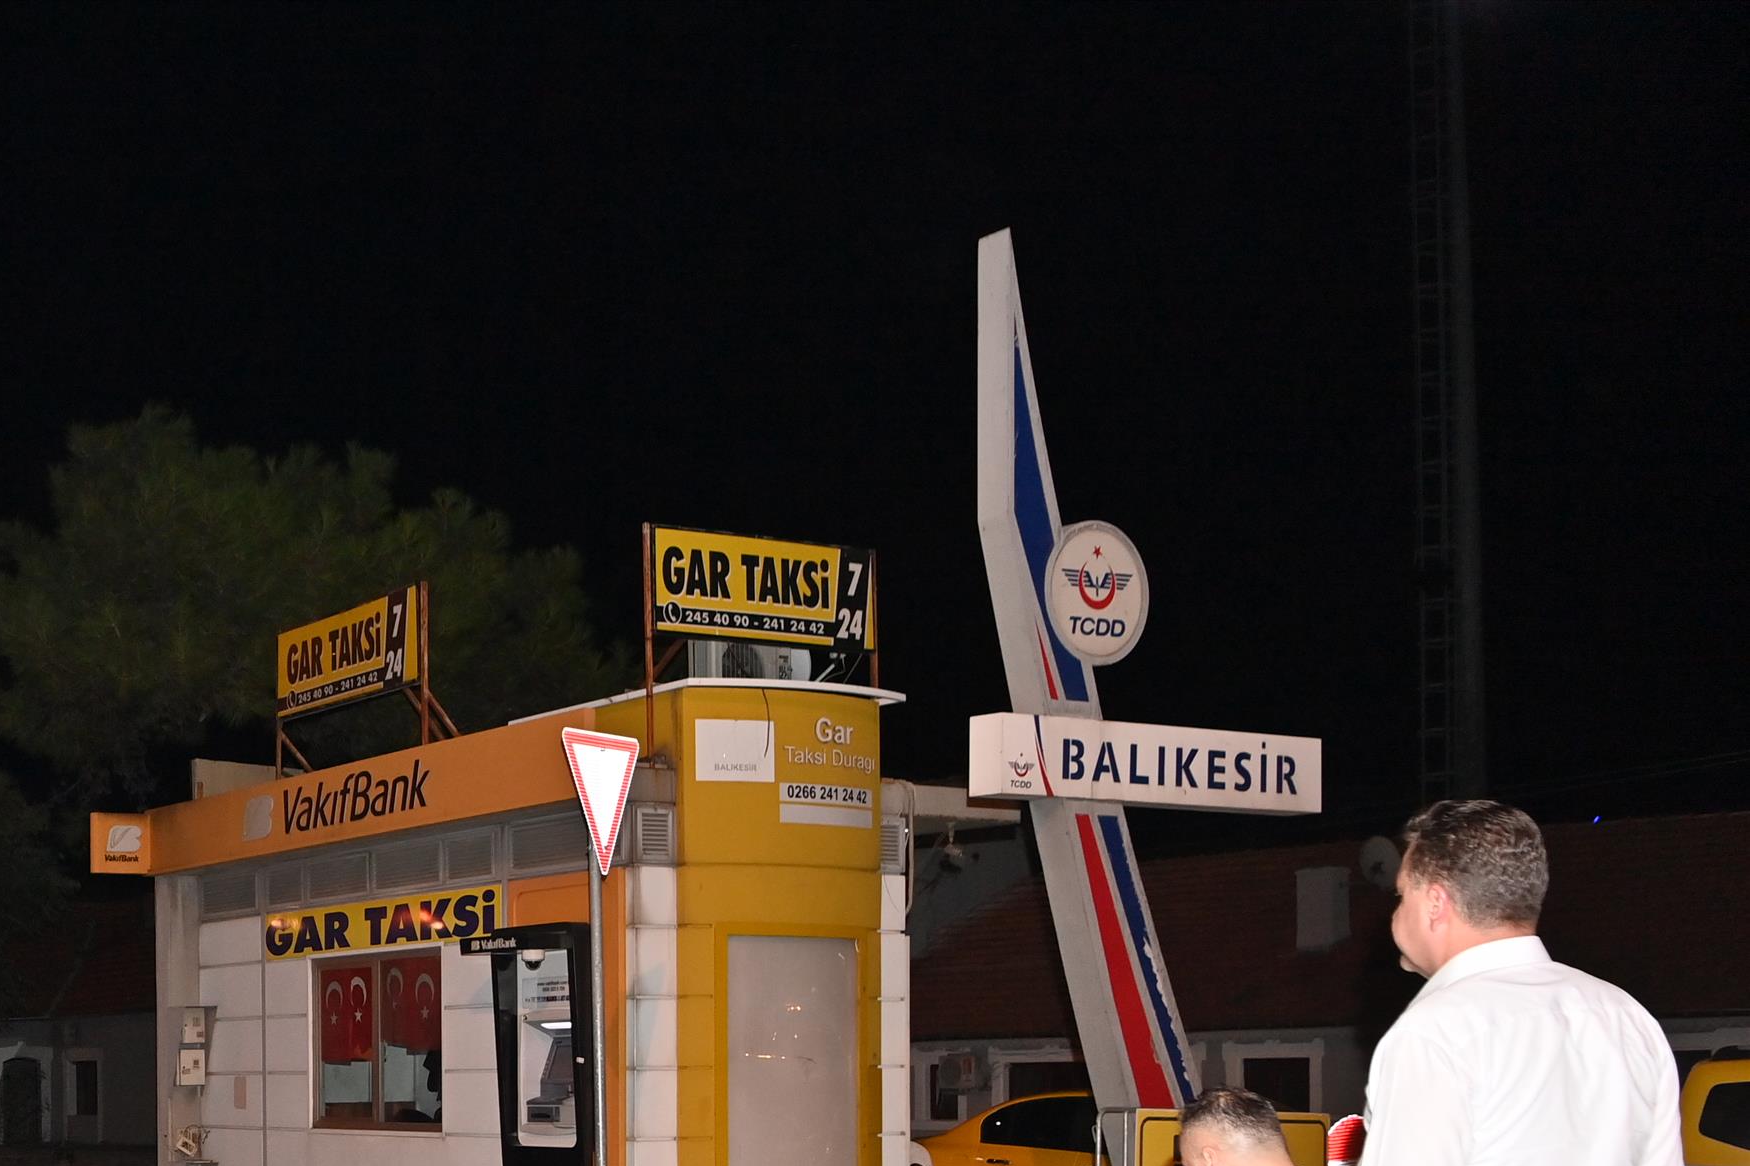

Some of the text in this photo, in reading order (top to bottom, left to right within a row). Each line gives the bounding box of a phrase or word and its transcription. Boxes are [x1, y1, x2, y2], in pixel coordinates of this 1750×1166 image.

[662, 546, 732, 600] GAR
[848, 562, 863, 597] 7
[392, 604, 403, 638] 7
[685, 611, 710, 624] 245
[714, 613, 730, 626] 40
[734, 615, 750, 628] 90
[763, 618, 785, 630] 241
[790, 620, 806, 632] 24
[809, 622, 825, 635] 42
[836, 608, 863, 640] 24
[1069, 616, 1126, 637] TCDD
[287, 636, 324, 685] GAR
[385, 648, 403, 681] 24
[298, 690, 311, 704] 245
[313, 687, 322, 699] 40
[324, 684, 333, 695] 90
[340, 678, 354, 691] 241
[356, 675, 366, 687] 24
[368, 671, 378, 683] 42
[815, 716, 854, 745] Gar
[784, 745, 827, 765] Taksi
[1061, 738, 1298, 795] BALIKESİR
[282, 759, 431, 835] VakıfBank
[787, 785, 867, 804] 0266 241 24 42
[1010, 779, 1032, 790] TCDD
[265, 911, 350, 957] GAR
